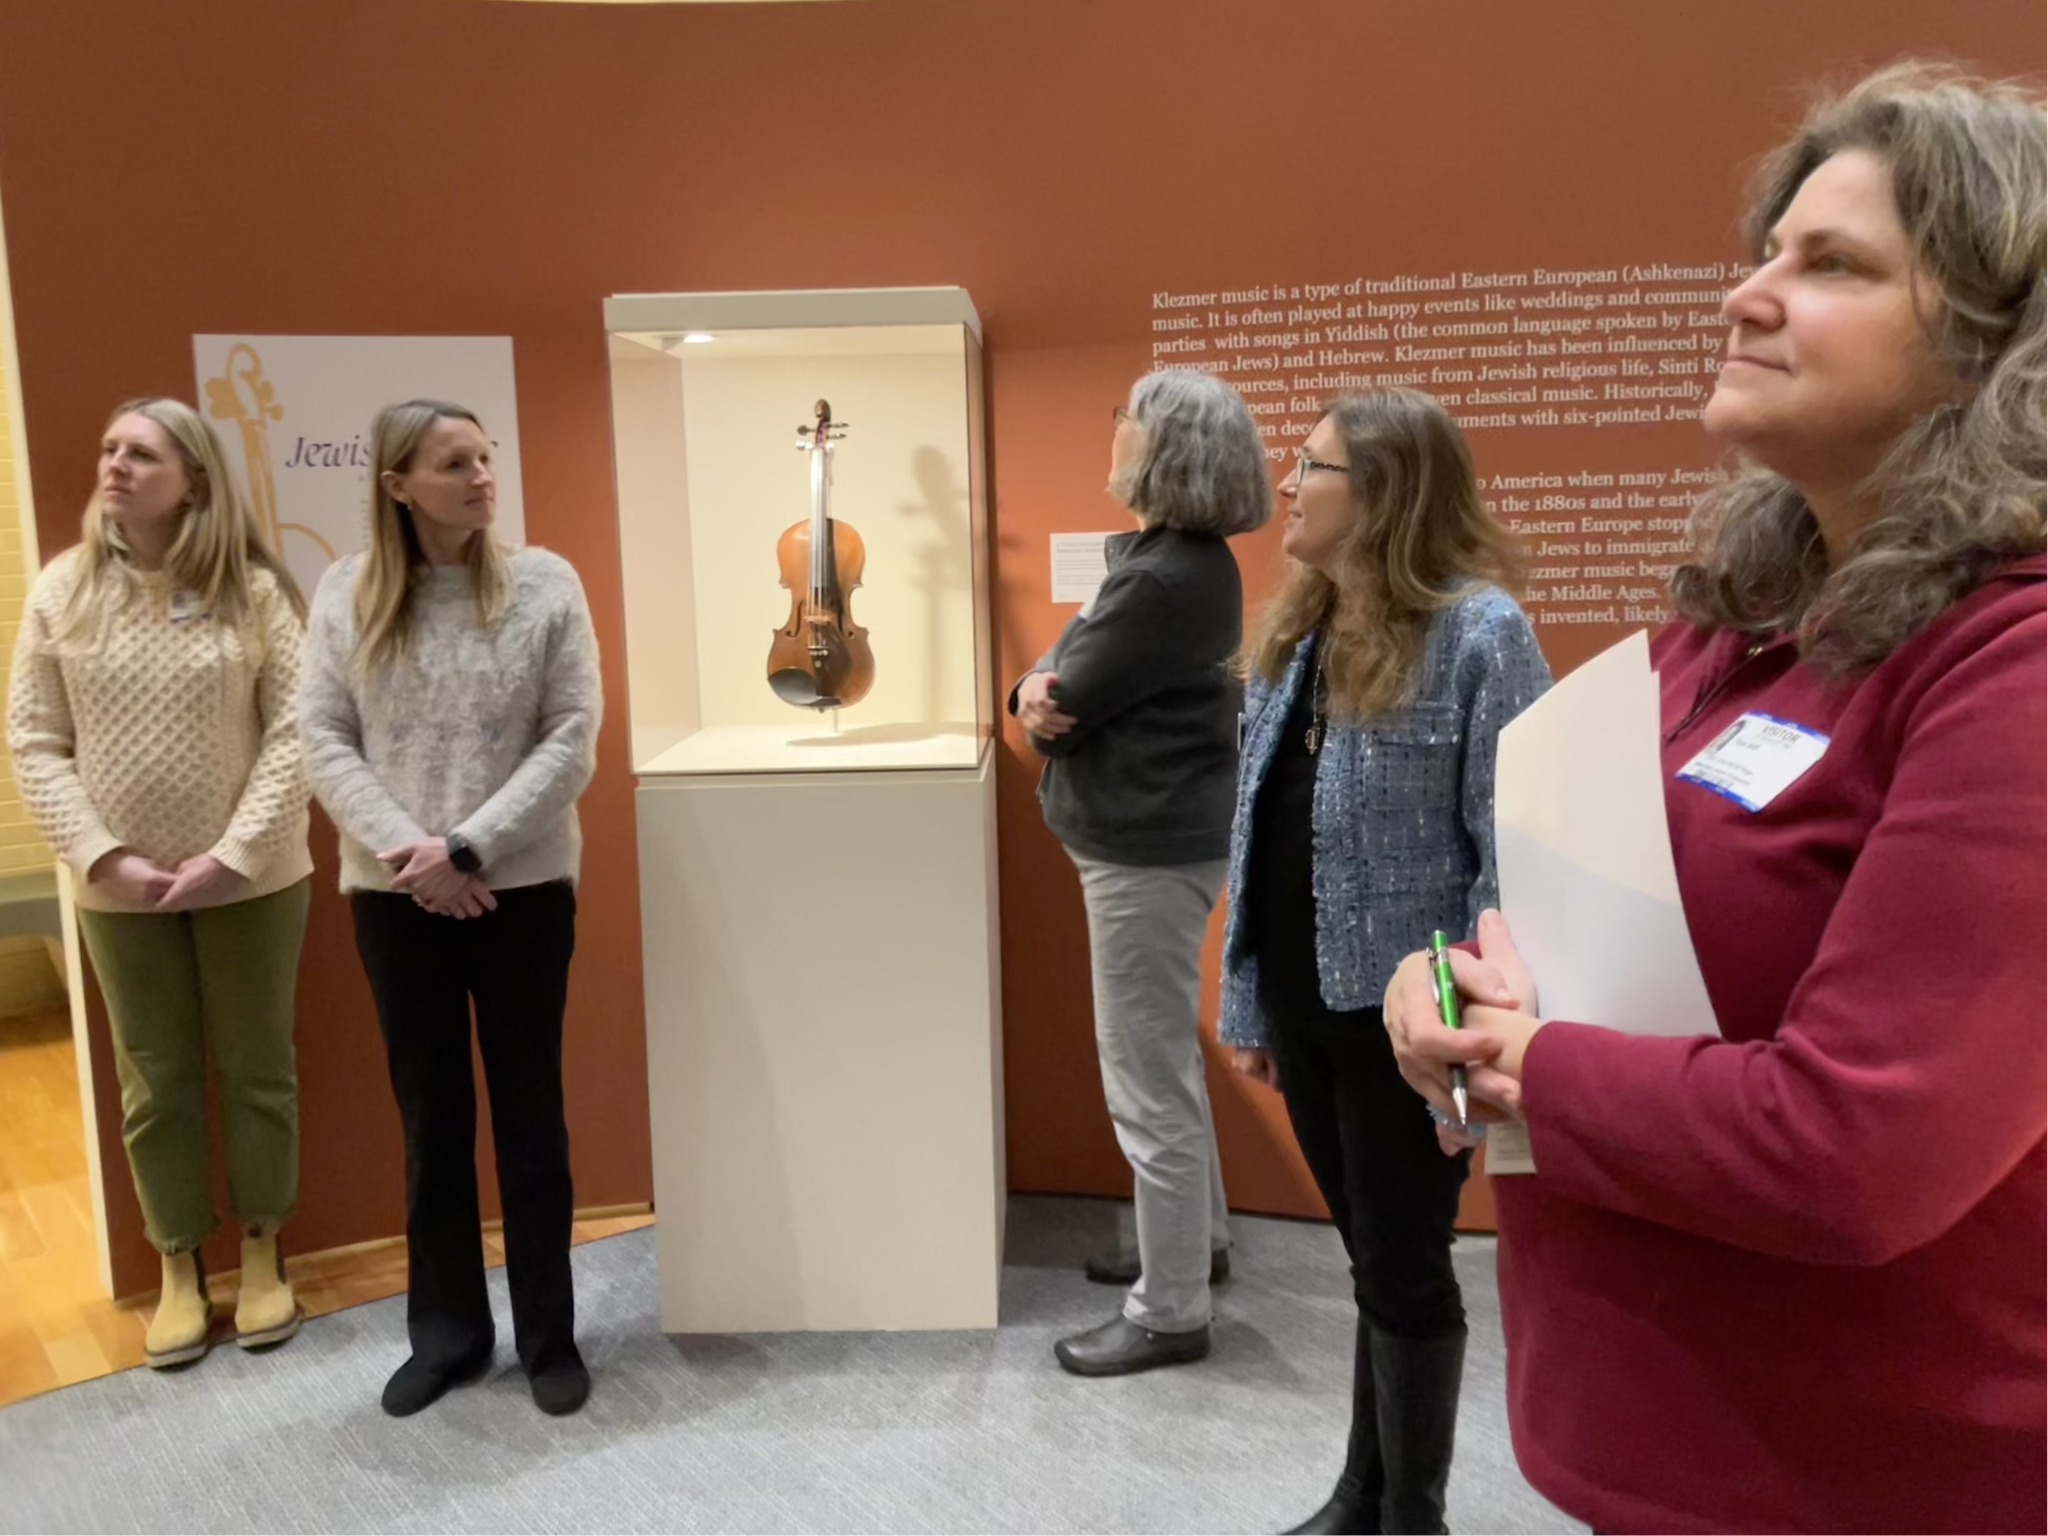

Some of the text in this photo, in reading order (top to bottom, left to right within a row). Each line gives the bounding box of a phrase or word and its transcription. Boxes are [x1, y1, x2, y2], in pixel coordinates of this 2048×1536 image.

[1152, 291, 1216, 309] Klezmer
[1222, 286, 1268, 304] music
[1273, 284, 1290, 300] is
[1290, 287, 1300, 300] a
[1304, 282, 1340, 301] type
[1344, 278, 1362, 295] of
[1366, 273, 1456, 294] traditional
[1462, 272, 1527, 289] Eastern
[1533, 268, 1617, 287] European
[1622, 262, 1725, 284] (Ashkenazi)
[1152, 286, 1729, 331] music. It is often played at happy events like weddings and communi
[1152, 335, 1206, 357] parties
[1215, 332, 1249, 349] with
[1254, 333, 1299, 350] songs
[1304, 329, 1320, 344] in
[1325, 323, 1388, 341] Yiddish
[1393, 321, 1428, 341] (the
[1432, 320, 1508, 338] common
[1513, 316, 1591, 336] language
[1596, 312, 1657, 331] spoken
[1662, 309, 1682, 332] by
[1232, 354, 1279, 371] Jews)
[1283, 350, 1313, 367] and
[1319, 348, 1389, 366] Hebrew.
[1394, 343, 1464, 363] Klezmer
[1470, 341, 1522, 358] music
[1526, 339, 1556, 356] has
[1561, 337, 1603, 354] been
[1608, 333, 1697, 353] influenced
[1702, 333, 1722, 354] by
[1228, 380, 1289, 394] ources,
[1294, 373, 1371, 391] including
[1376, 369, 1427, 386] music
[1432, 366, 1473, 383] from
[1477, 363, 1537, 381] Jewish
[1542, 360, 1617, 380] religious
[1622, 358, 1653, 376] life,
[1658, 357, 1698, 374] Sinti
[1290, 396, 1321, 413] folk
[1466, 387, 1537, 405] classical
[1543, 384, 1598, 402] music.
[1604, 380, 1708, 401] Historically,
[1521, 408, 1558, 425] with
[1564, 404, 1661, 427] six-pointed
[285, 435, 370, 468] Jewis
[1491, 472, 1562, 490] America
[1568, 470, 1613, 487] when
[1619, 473, 1667, 488] many
[1502, 495, 1529, 512] the
[1535, 494, 1586, 511] 1880s
[1590, 492, 1622, 510] and
[1628, 491, 1655, 508] the
[1509, 518, 1575, 534] Eastern
[1581, 516, 1643, 534] Europe
[1536, 541, 1580, 557] Jews
[1585, 540, 1602, 555] to
[1607, 537, 1695, 557] immigrate
[1584, 561, 1635, 578] music
[1526, 583, 1661, 602] he Middle Ages.
[1540, 606, 1620, 624] invented,
[1624, 605, 1669, 624] likely
[1762, 724, 1802, 745] VISITOR
